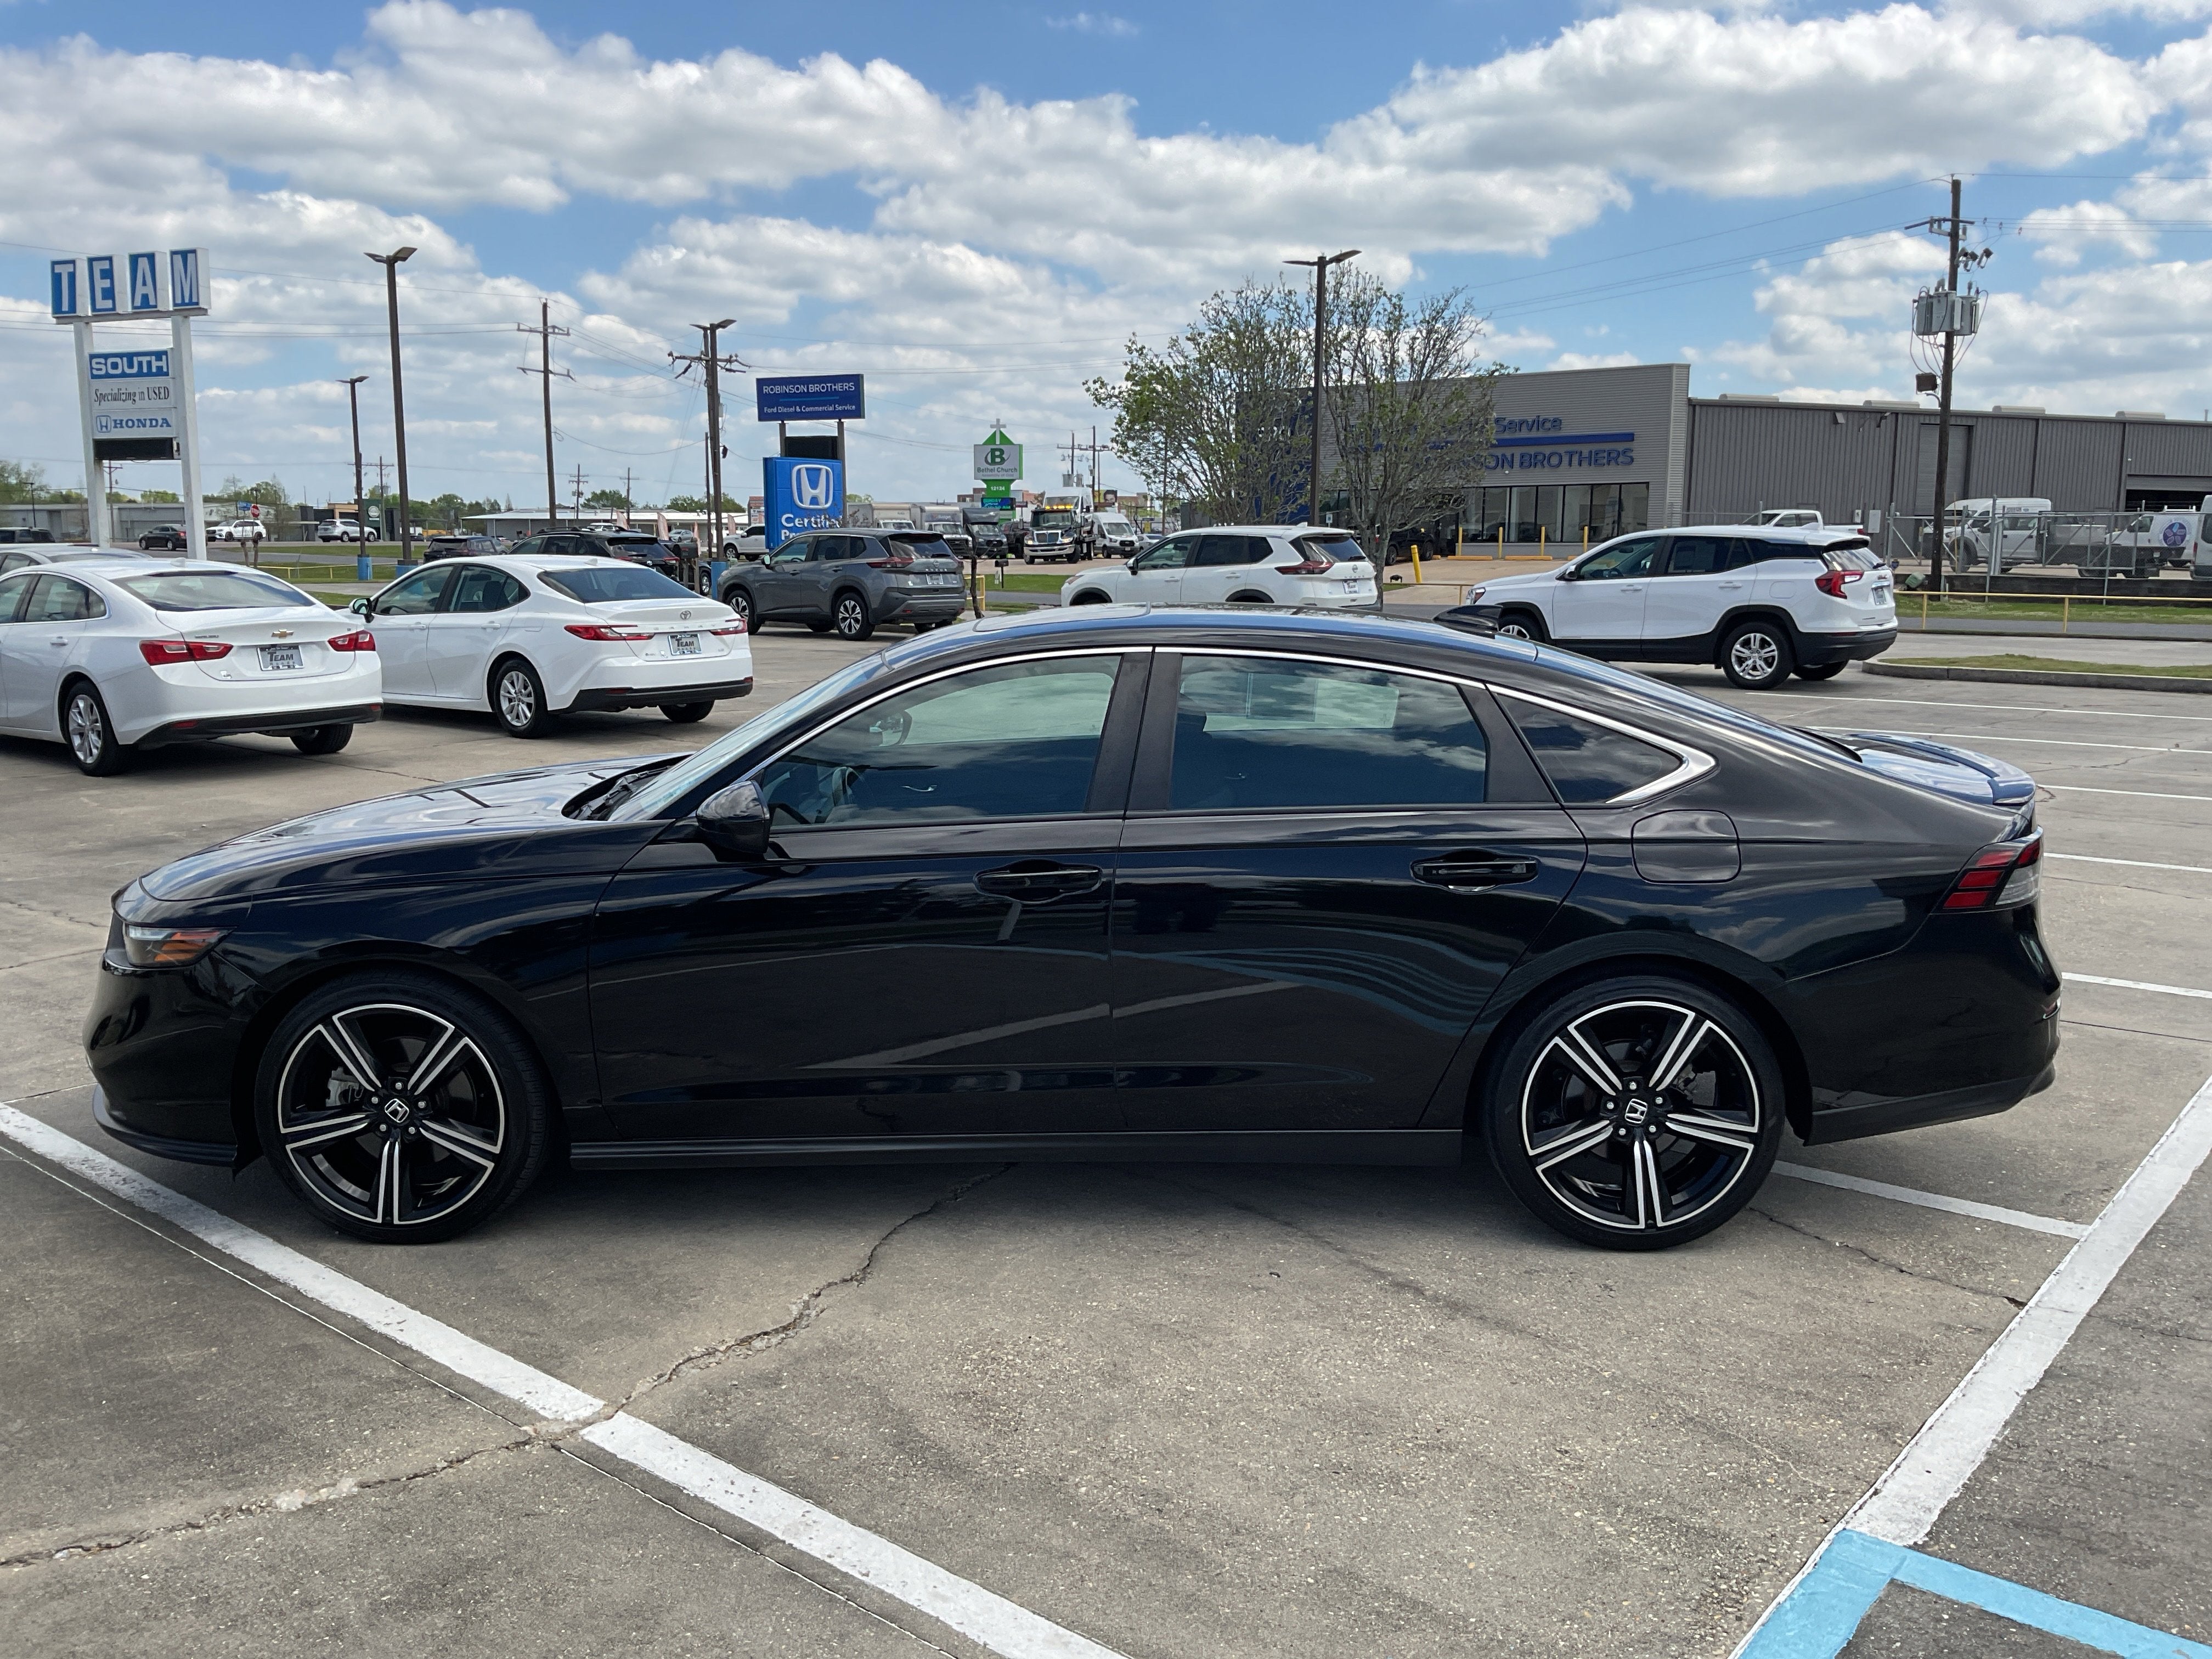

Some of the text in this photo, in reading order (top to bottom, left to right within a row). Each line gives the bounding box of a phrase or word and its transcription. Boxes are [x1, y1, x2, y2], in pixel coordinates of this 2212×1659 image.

[54, 252, 199, 312] TEAM
[91, 355, 167, 375] SOUTH
[94, 386, 170, 405] Specializing in USED
[763, 382, 855, 394] ROBINSON BROTHERS
[112, 417, 172, 429] HONDA
[1494, 415, 1562, 433] Service
[1519, 448, 1634, 469] BROTHERS
[675, 638, 694, 647] TEAM
[267, 651, 294, 662] TEAM
